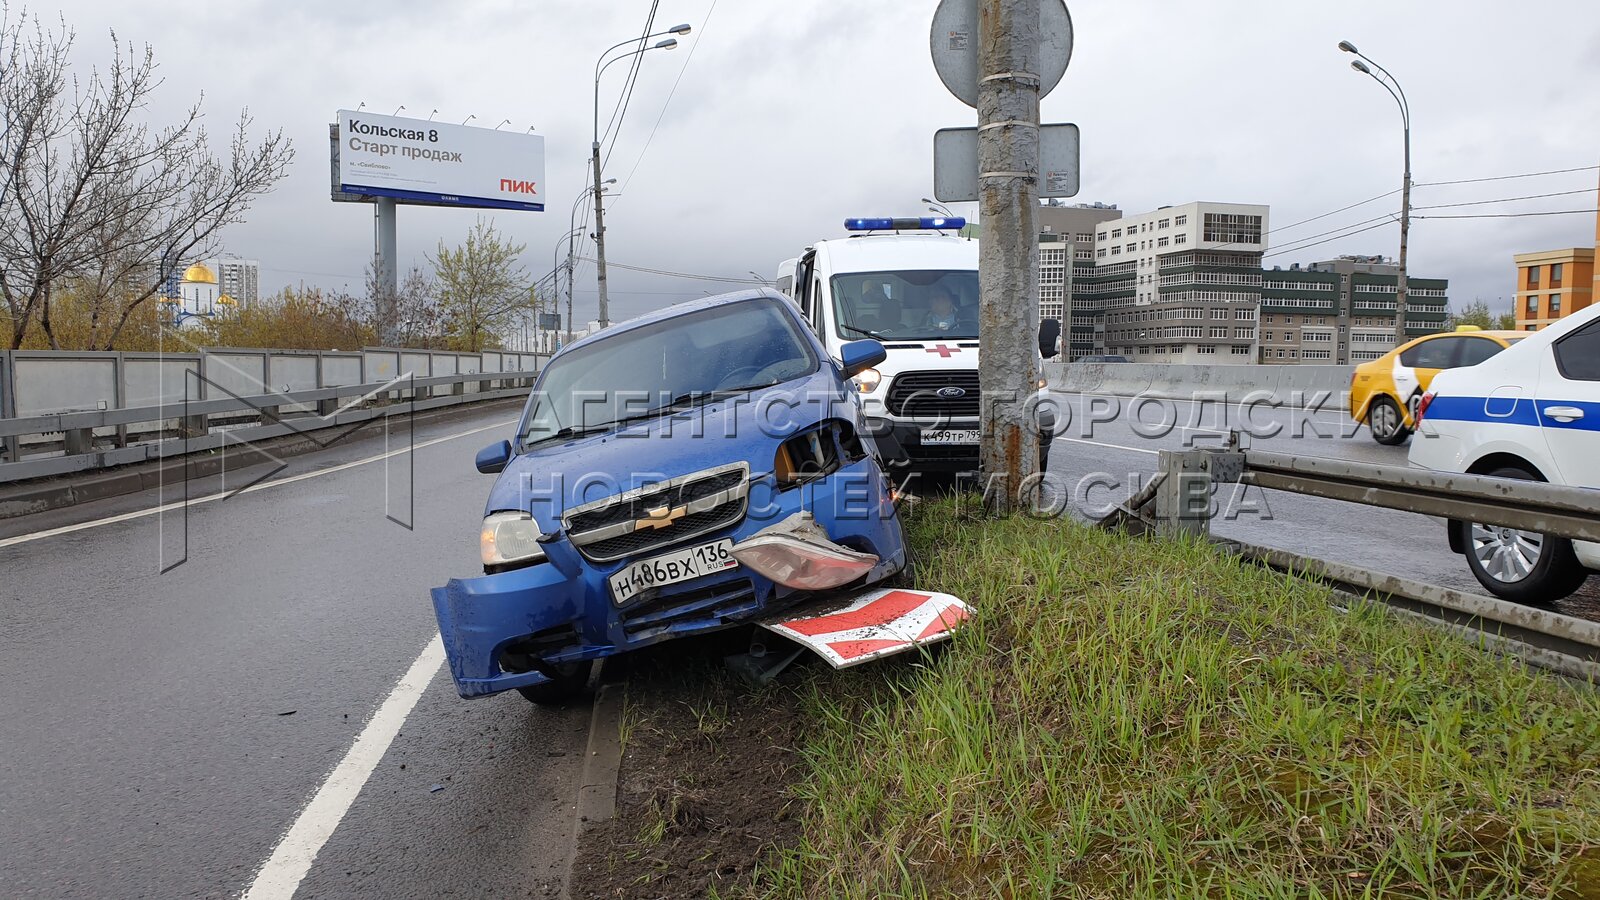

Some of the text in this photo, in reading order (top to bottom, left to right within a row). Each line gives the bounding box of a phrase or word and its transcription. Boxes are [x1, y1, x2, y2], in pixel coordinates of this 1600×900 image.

[349, 119, 439, 143] Кольская 8
[348, 137, 463, 163] Старт продаж
[500, 178, 537, 195] ПИК
[943, 388, 960, 396] Ford
[618, 543, 728, 597] Н486ВХ 136
[707, 560, 724, 571] RUS
